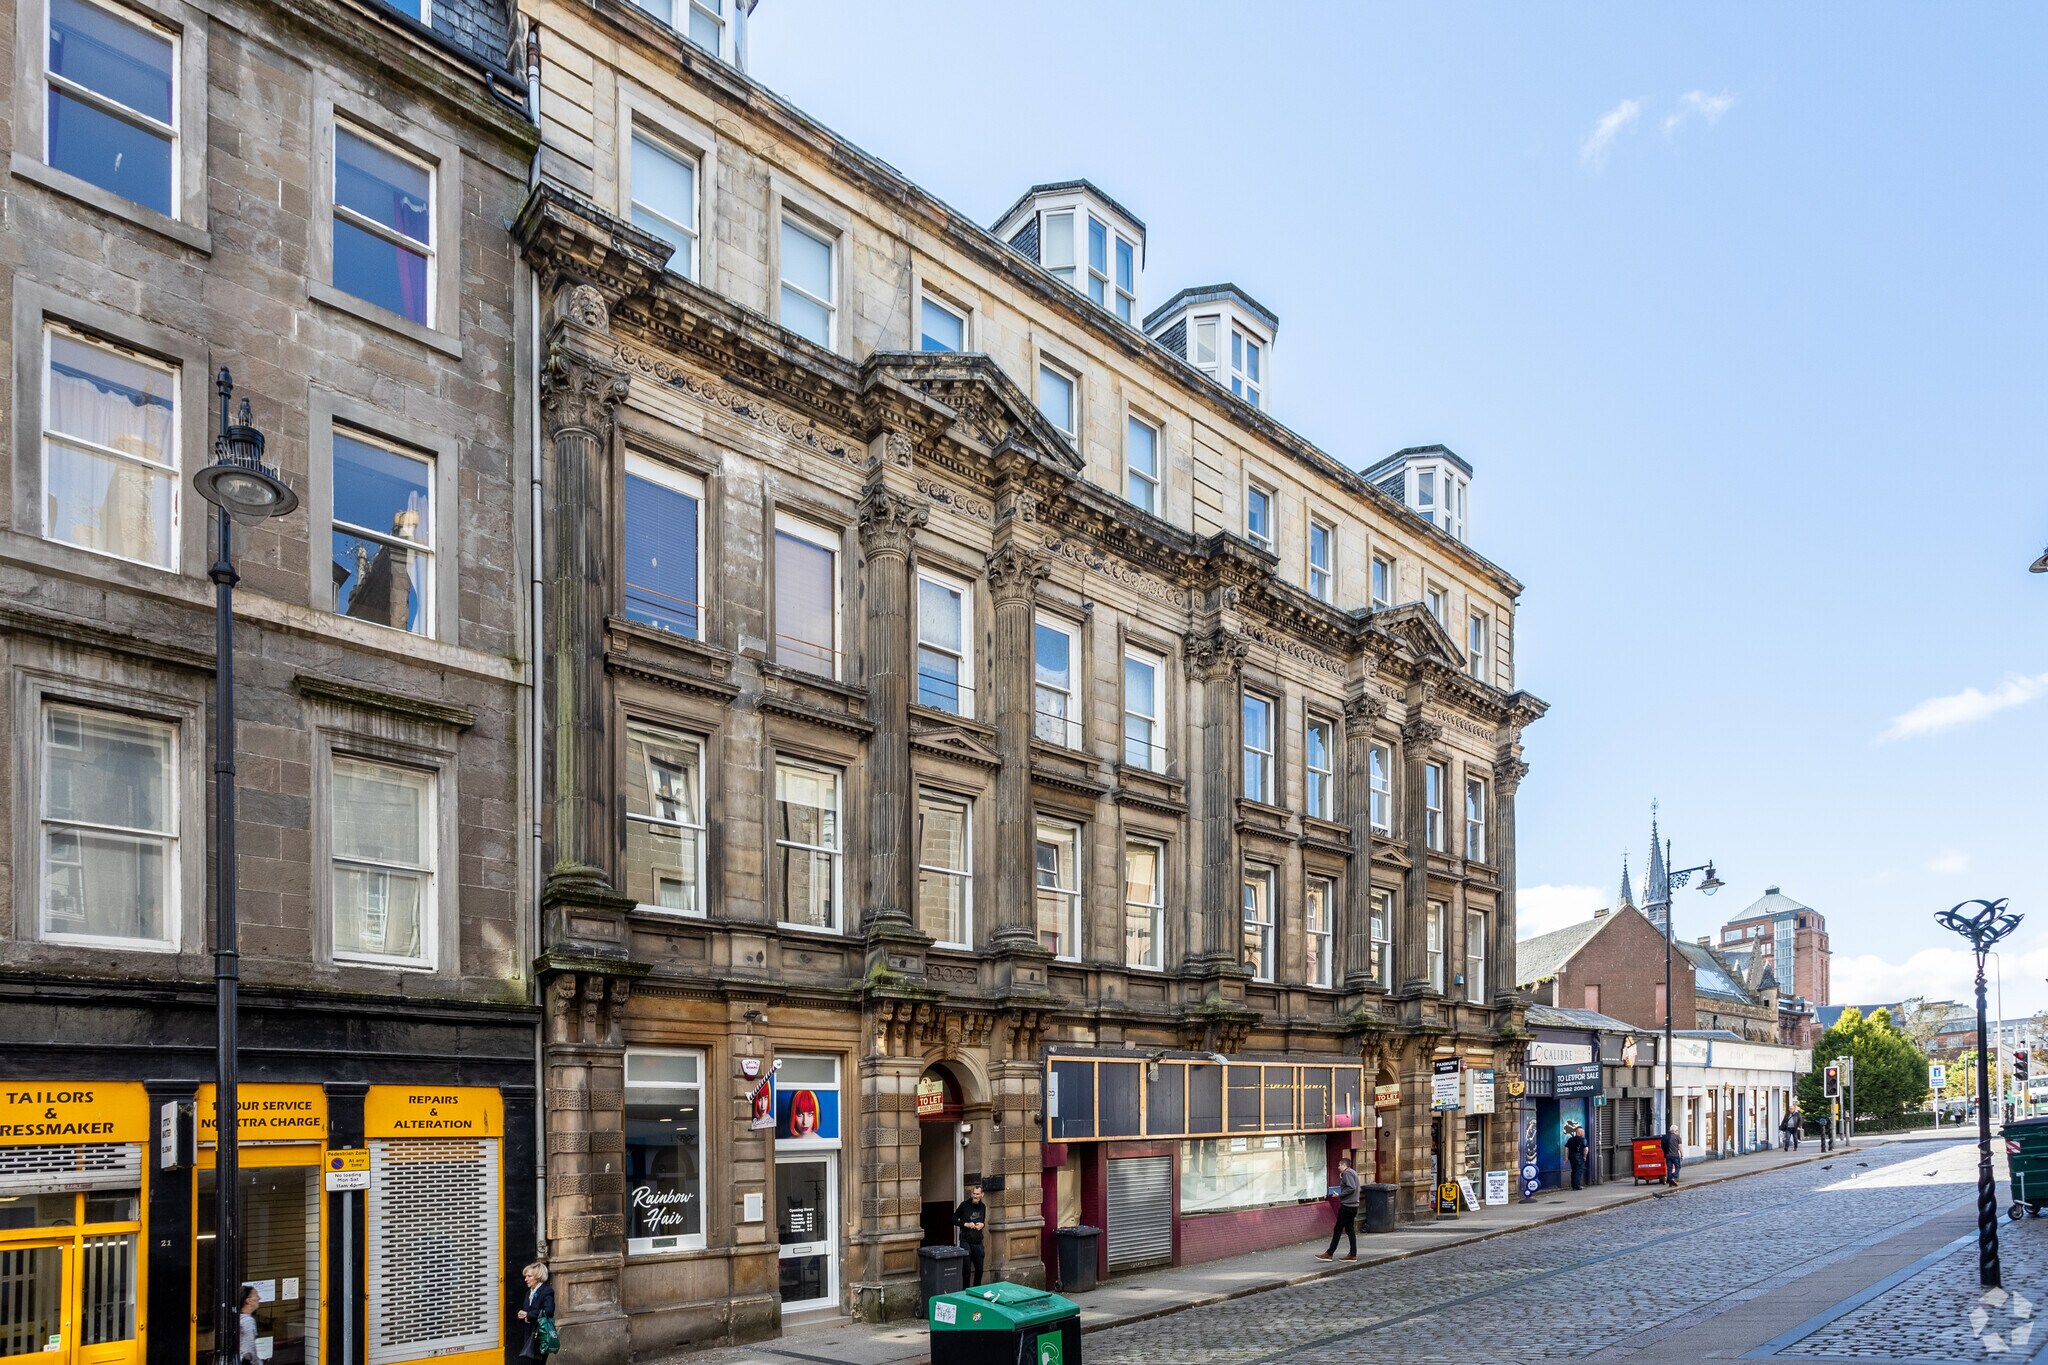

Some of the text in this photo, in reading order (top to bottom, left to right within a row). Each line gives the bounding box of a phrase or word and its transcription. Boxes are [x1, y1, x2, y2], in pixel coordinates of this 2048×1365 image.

[1544, 1048, 1573, 1061] CALIBRE
[1586, 1072, 1599, 1080] SALE
[6, 1091, 94, 1104] TAILORS
[408, 1095, 459, 1105] REPAIRS
[920, 1098, 929, 1106] TO
[929, 1095, 942, 1104] LET
[263, 1101, 312, 1111] SERVICE
[44, 1107, 57, 1119] &
[429, 1107, 438, 1117] &
[270, 1117, 320, 1128] CHARGE
[394, 1120, 472, 1129] ALTERATION
[0, 1122, 114, 1137] RESSMAKER
[632, 1186, 695, 1208] Rainbow
[643, 1206, 684, 1232] Hair
[161, 1239, 171, 1247] 21
